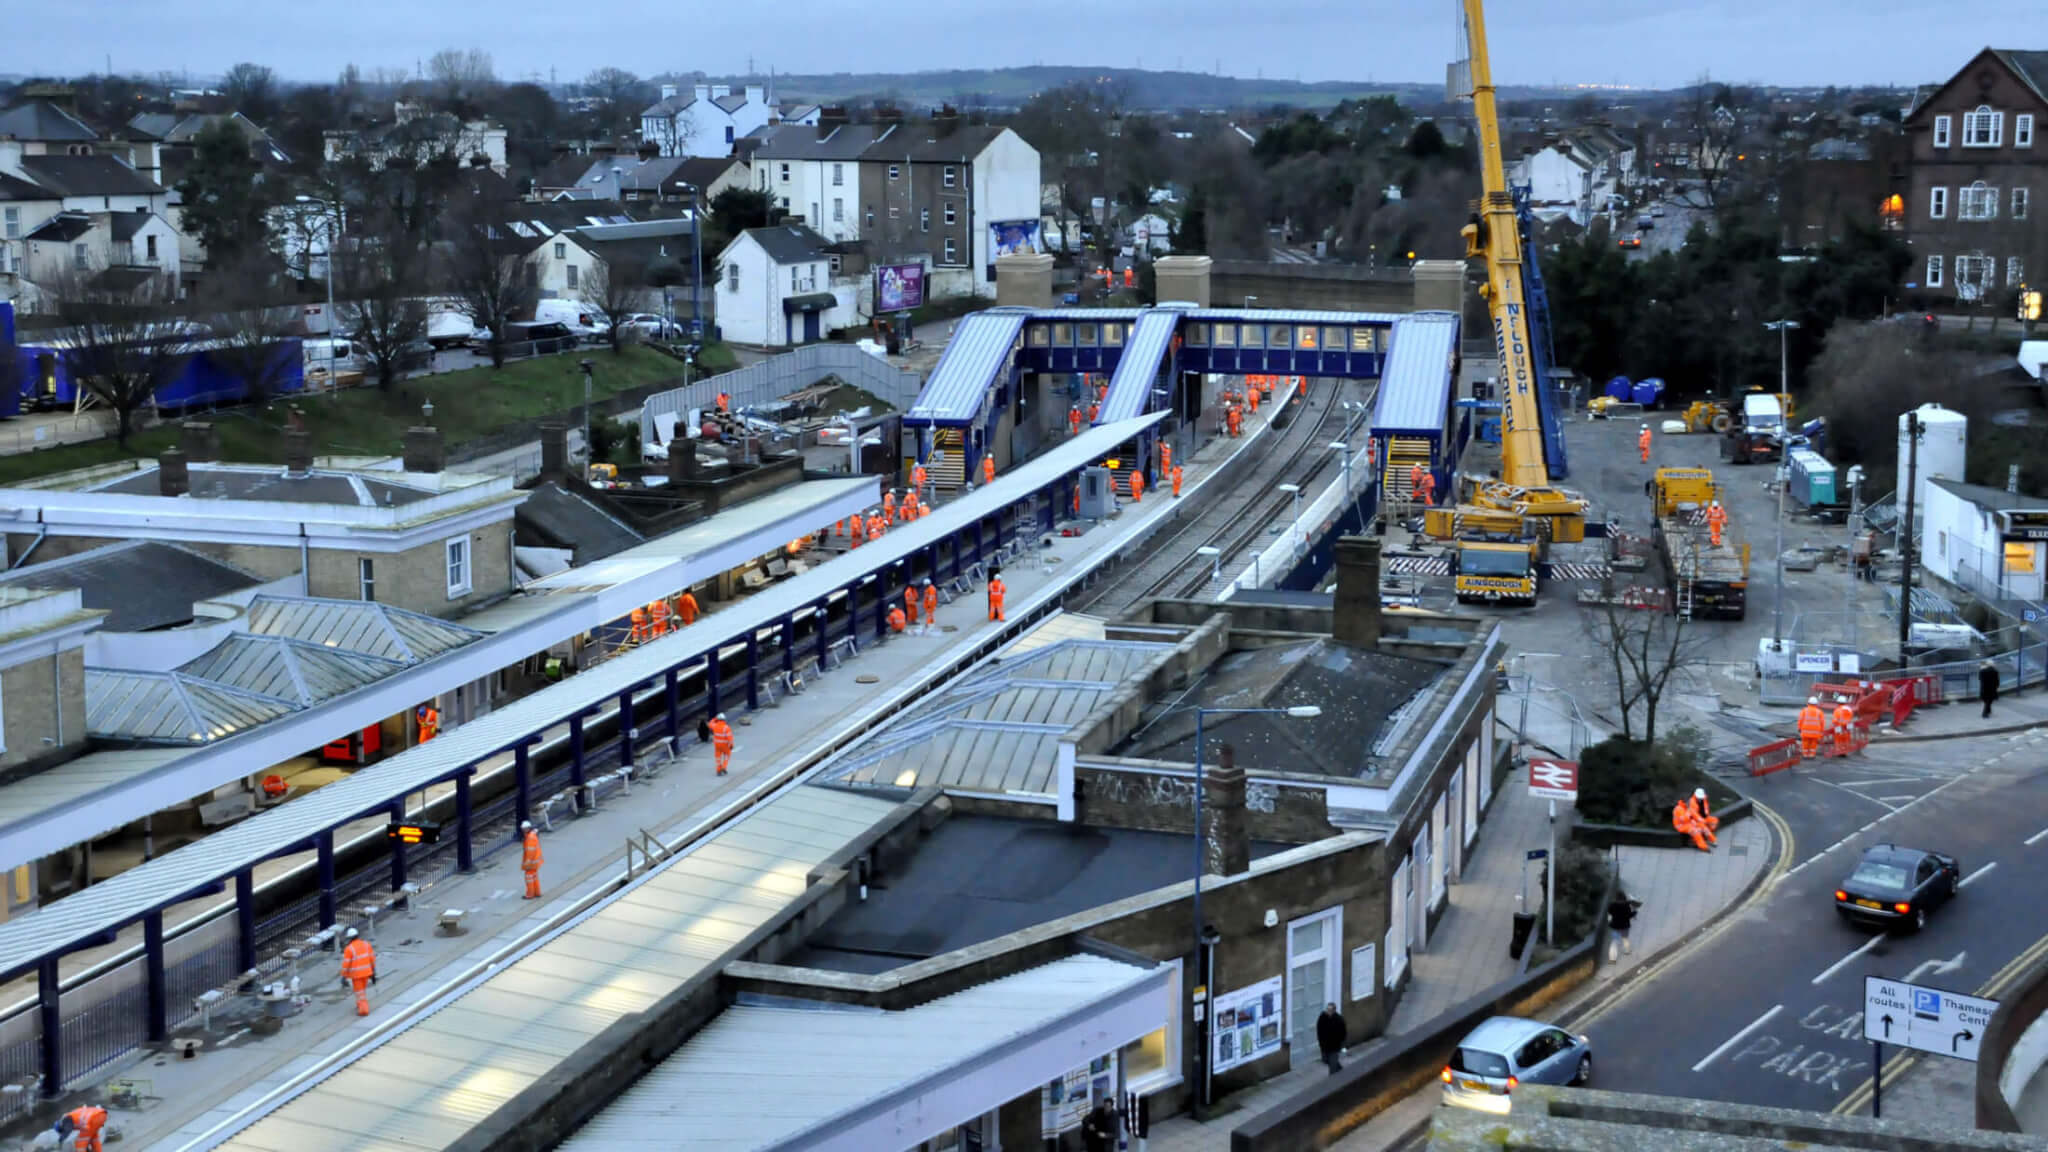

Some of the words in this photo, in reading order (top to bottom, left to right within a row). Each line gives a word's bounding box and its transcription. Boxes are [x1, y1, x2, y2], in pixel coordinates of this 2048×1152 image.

[1464, 578, 1522, 589] AINSCOUGH
[1799, 656, 1830, 664] SPENCER
[1880, 985, 1896, 997] All
[1869, 996, 1906, 1010] routes
[1917, 992, 1930, 1009] P
[1957, 1012, 1988, 1027] Cent
[1731, 1035, 1868, 1091] PARK
